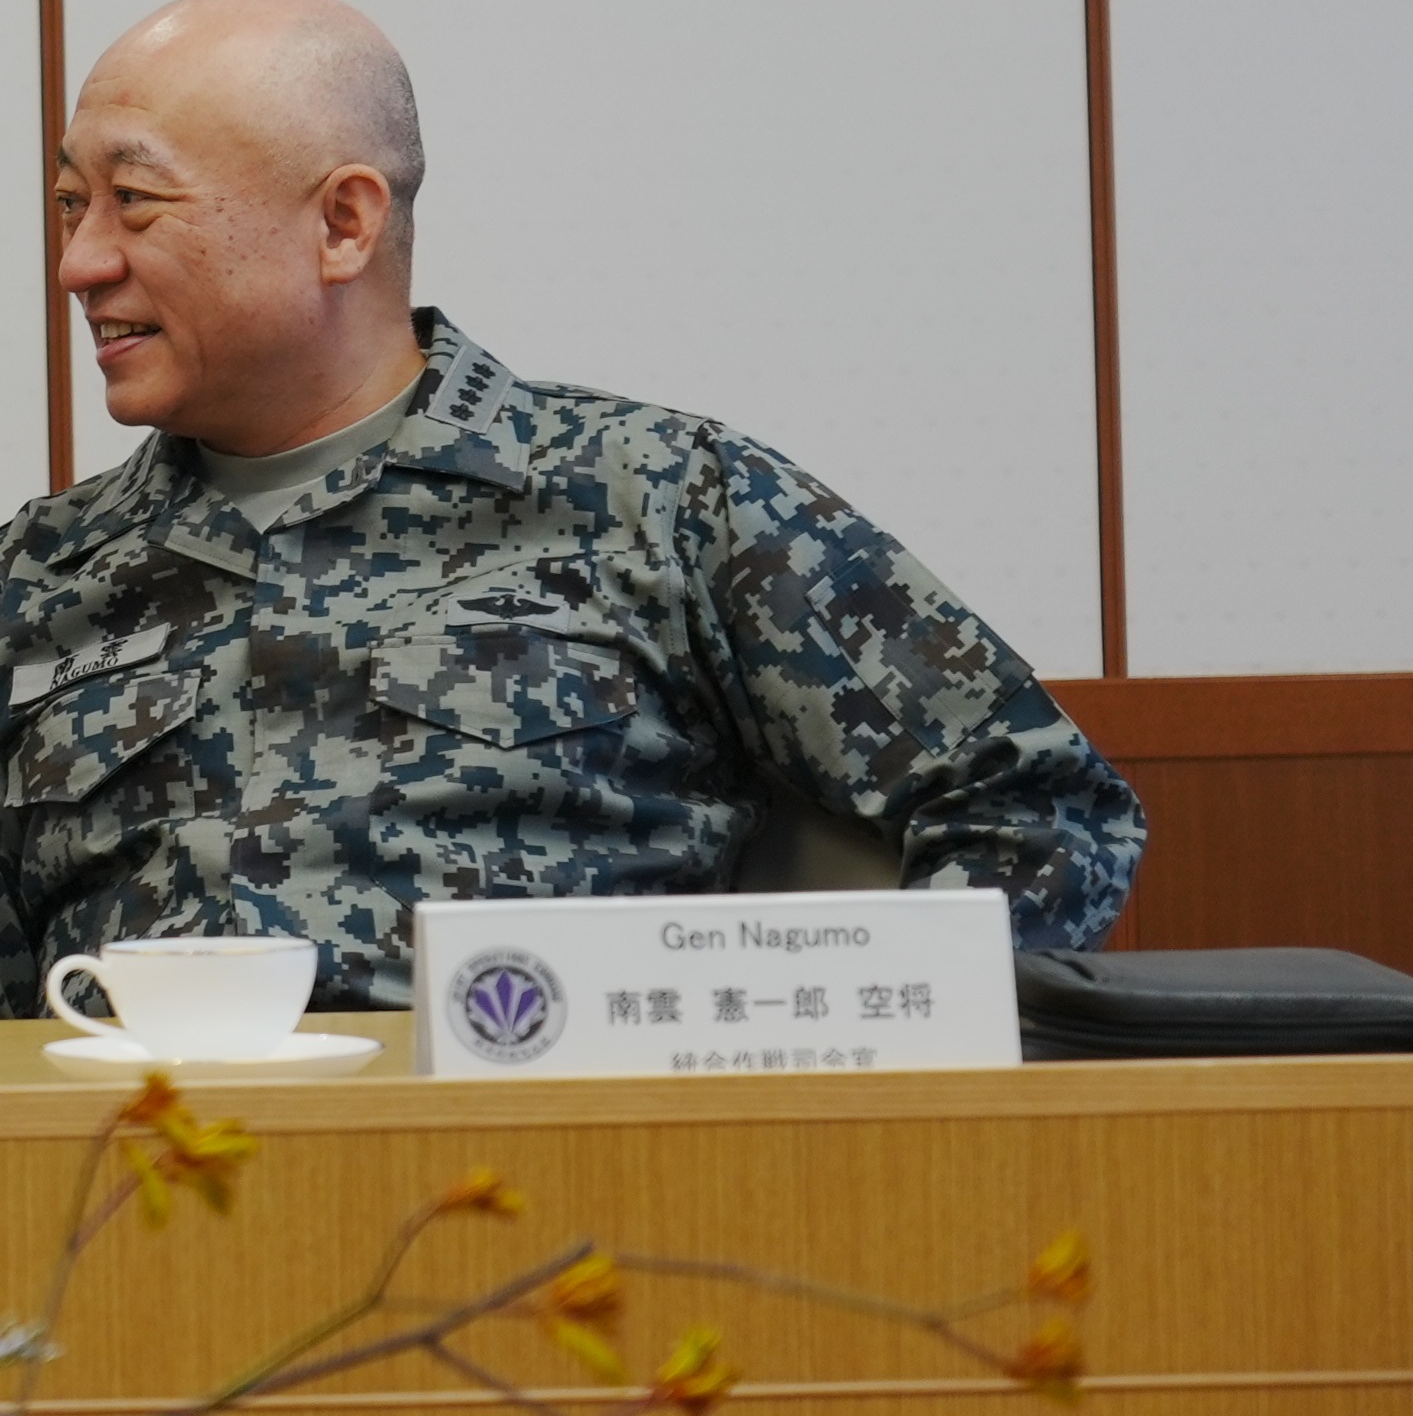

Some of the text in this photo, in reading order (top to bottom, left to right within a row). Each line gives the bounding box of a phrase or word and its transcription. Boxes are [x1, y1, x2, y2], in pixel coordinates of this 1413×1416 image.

[50, 656, 119, 691] NAGUMO
[662, 920, 871, 953] Gen Nagumo
[606, 983, 934, 1026] 南雲 憲一郎 空将
